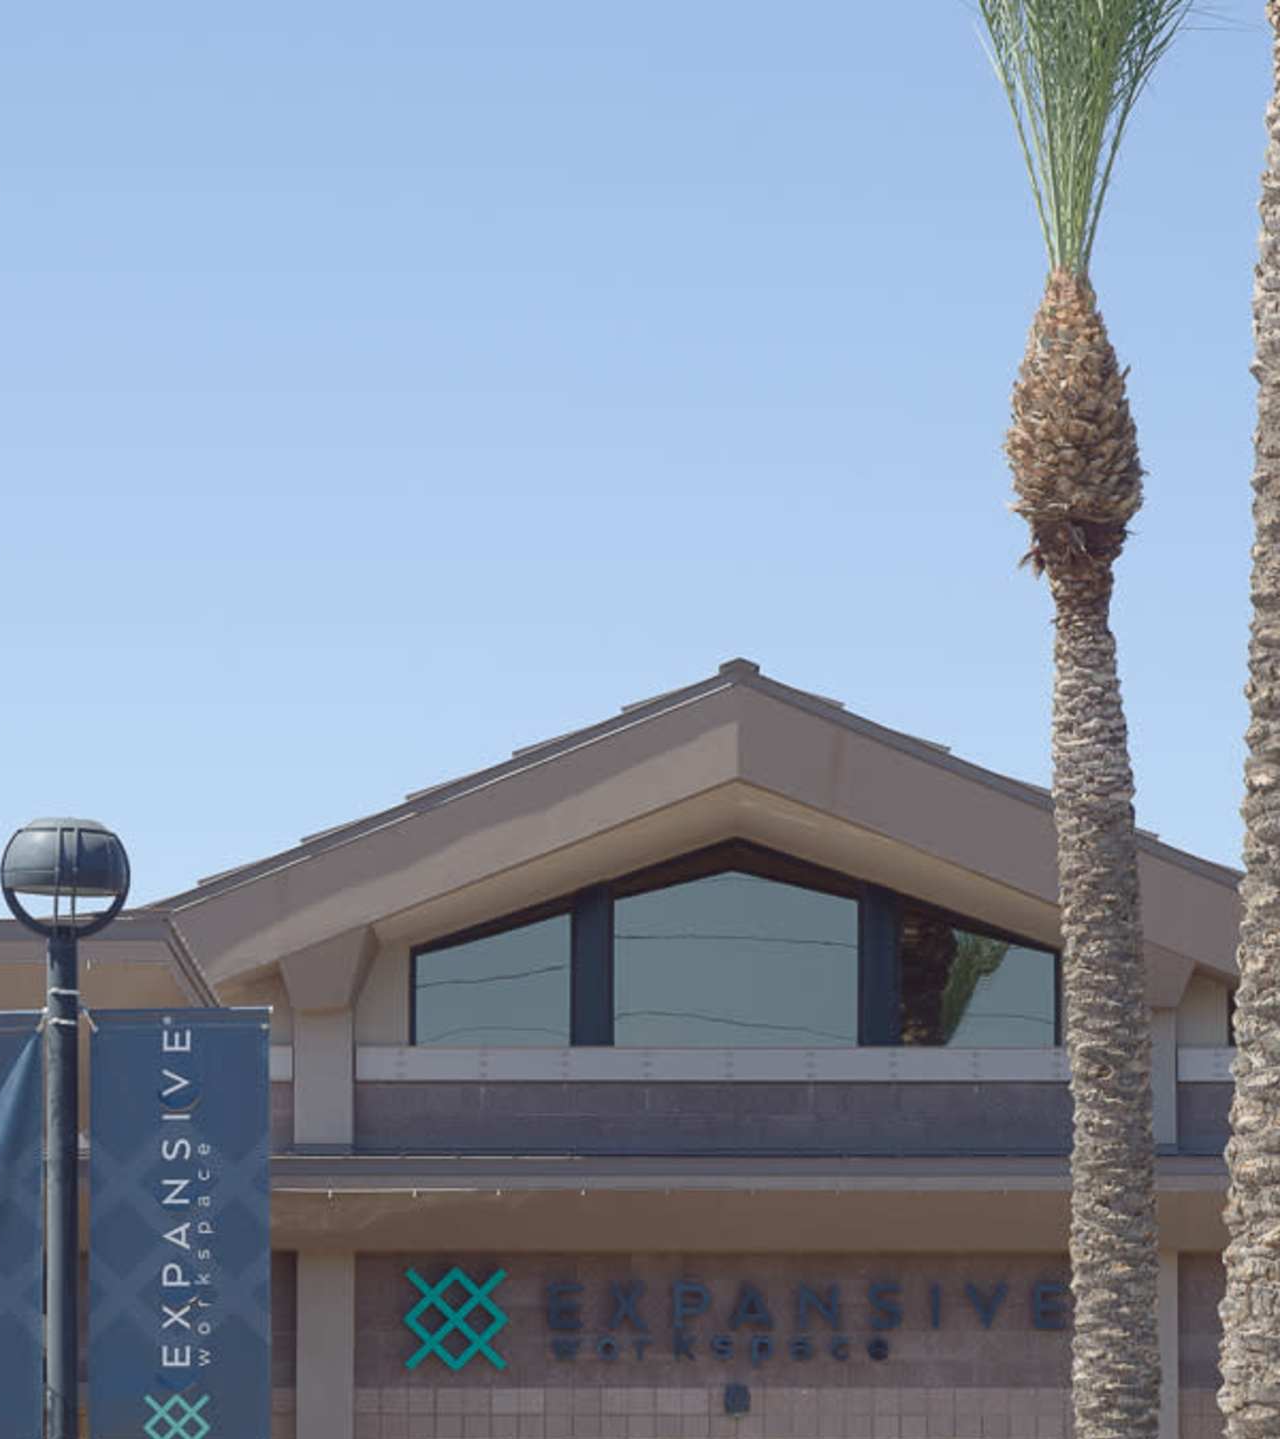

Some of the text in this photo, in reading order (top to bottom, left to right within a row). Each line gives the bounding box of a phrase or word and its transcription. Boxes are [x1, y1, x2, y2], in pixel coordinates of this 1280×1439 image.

[162, 1029, 192, 1368] EXPANSIVE
[194, 1142, 212, 1366] workspace
[545, 1280, 1072, 1330] EXPANSIVE
[552, 1334, 890, 1366] workspace
